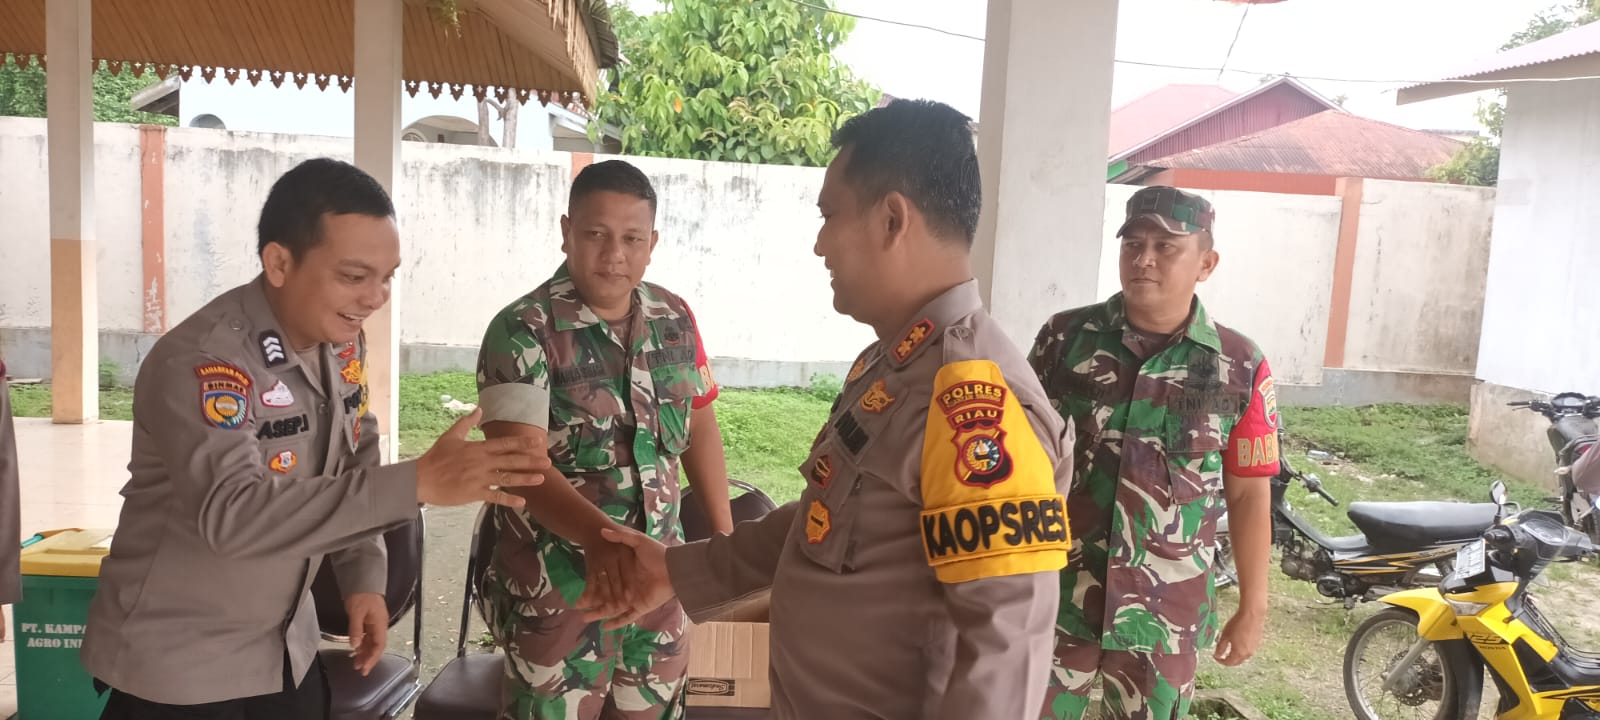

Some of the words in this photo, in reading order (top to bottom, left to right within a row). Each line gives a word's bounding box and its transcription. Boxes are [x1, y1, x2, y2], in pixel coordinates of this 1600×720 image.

[943, 384, 1002, 405] POLRES
[954, 409, 997, 424] RIAU
[923, 499, 1066, 558] KAOPSRES
[22, 623, 42, 633] PT.
[27, 637, 61, 648] AGRO
